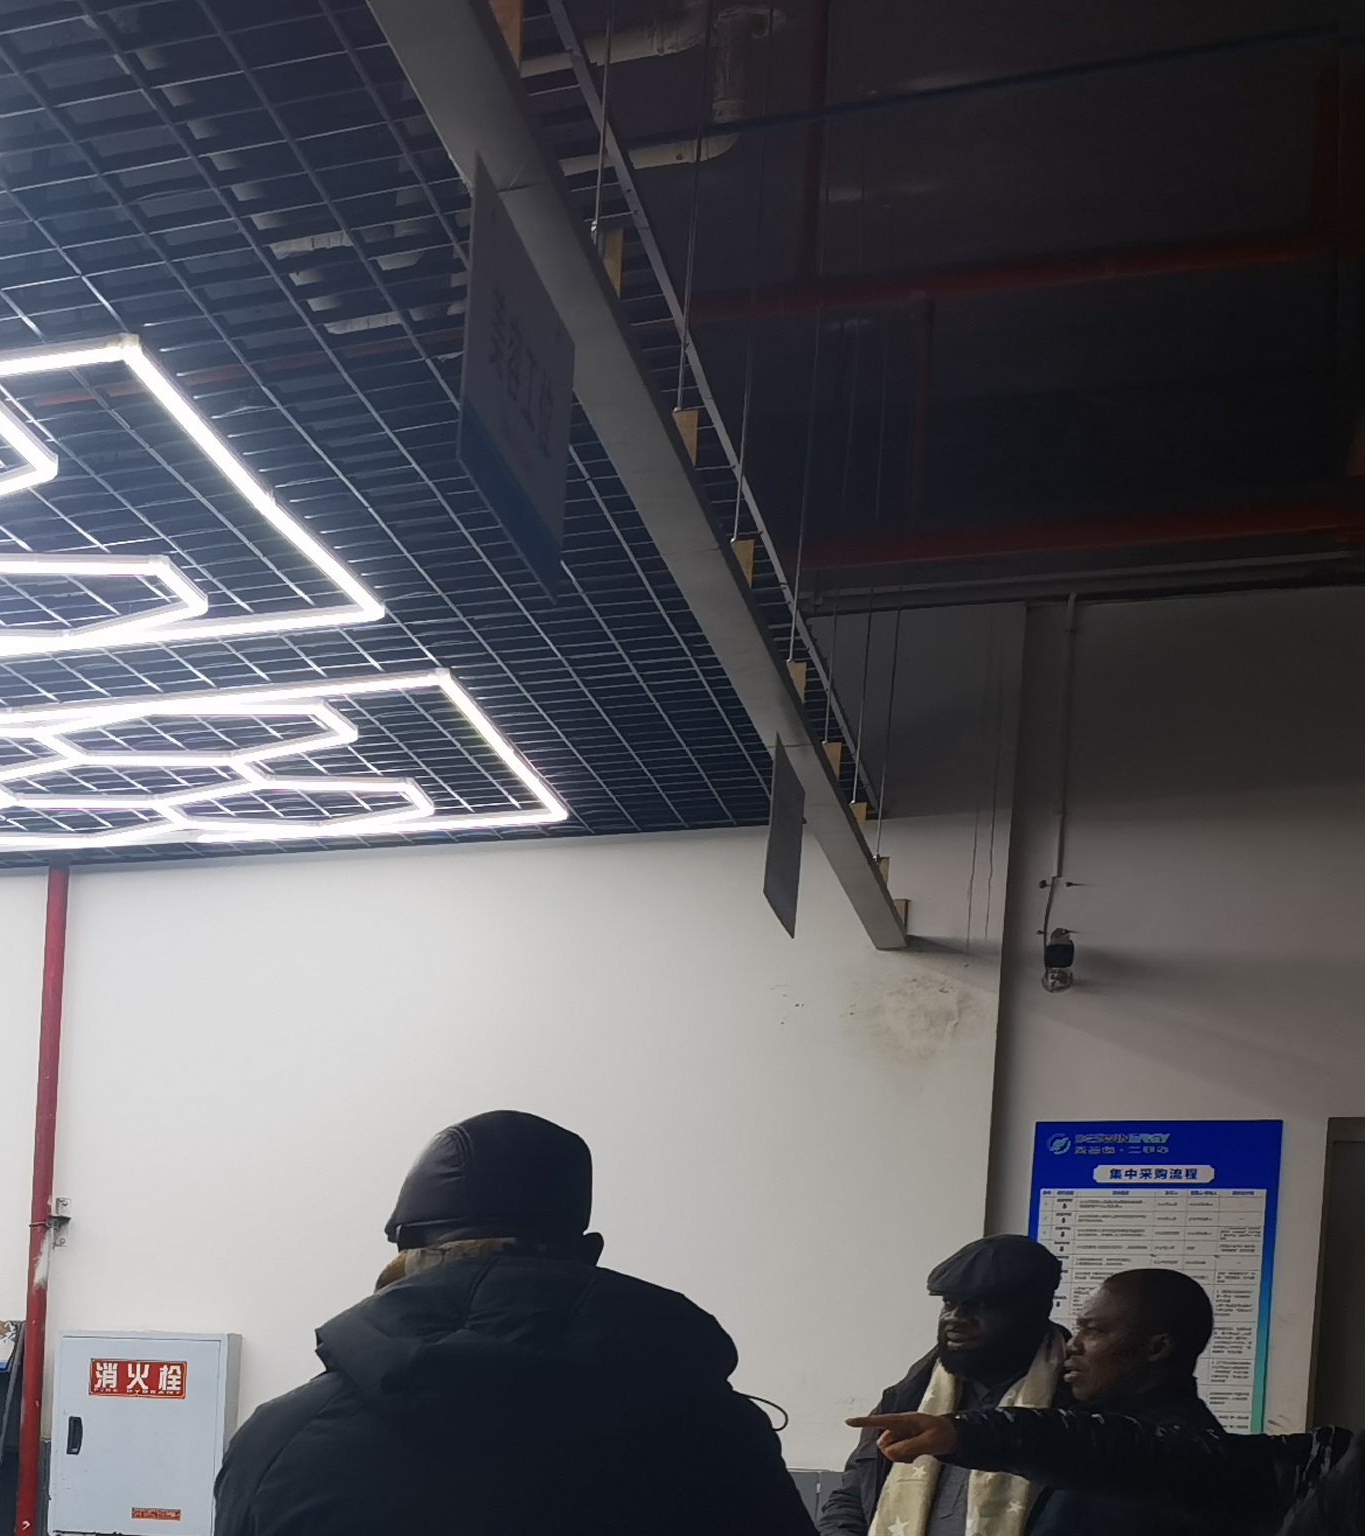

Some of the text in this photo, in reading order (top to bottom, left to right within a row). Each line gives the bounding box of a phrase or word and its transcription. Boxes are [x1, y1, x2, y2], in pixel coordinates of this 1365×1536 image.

[1109, 1168, 1198, 1180] 集中采购流程
[94, 1362, 182, 1391] 消火栓
